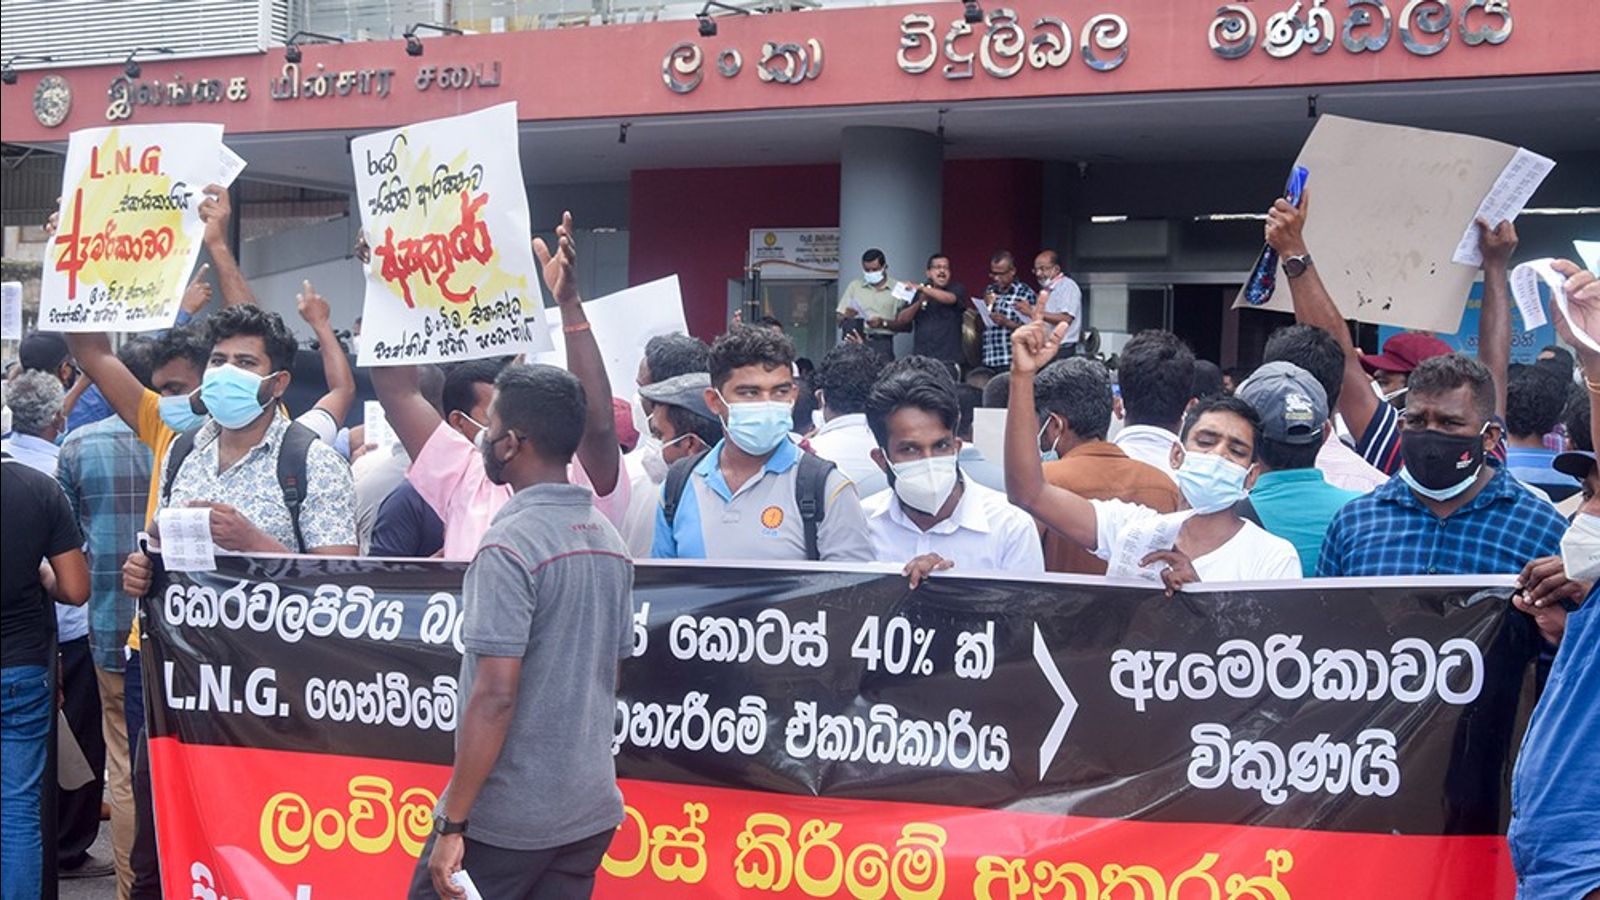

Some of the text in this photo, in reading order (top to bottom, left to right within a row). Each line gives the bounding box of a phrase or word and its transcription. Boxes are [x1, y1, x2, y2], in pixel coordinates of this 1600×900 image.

[270, 62, 395, 100] மின்சார
[415, 61, 502, 91] சபை
[662, 0, 1514, 94] ලංකා විදුලිබල මණඩලය
[89, 145, 166, 179] L.N.G.
[163, 581, 404, 643] කෙරවලපිටිය
[669, 607, 829, 668] කොටස්
[851, 615, 935, 676] 40%
[954, 620, 996, 680] ක්
[1109, 633, 1485, 713] ඇමෙරිකාවට
[163, 660, 290, 719] L.N.G.
[306, 672, 459, 732] ගෙන්වීමේ
[784, 700, 1012, 773] ඒකාධිකාරිය
[1186, 723, 1402, 806] විකුණයි
[259, 775, 438, 865] ලංවිම
[733, 812, 948, 900] කිරීමේ
